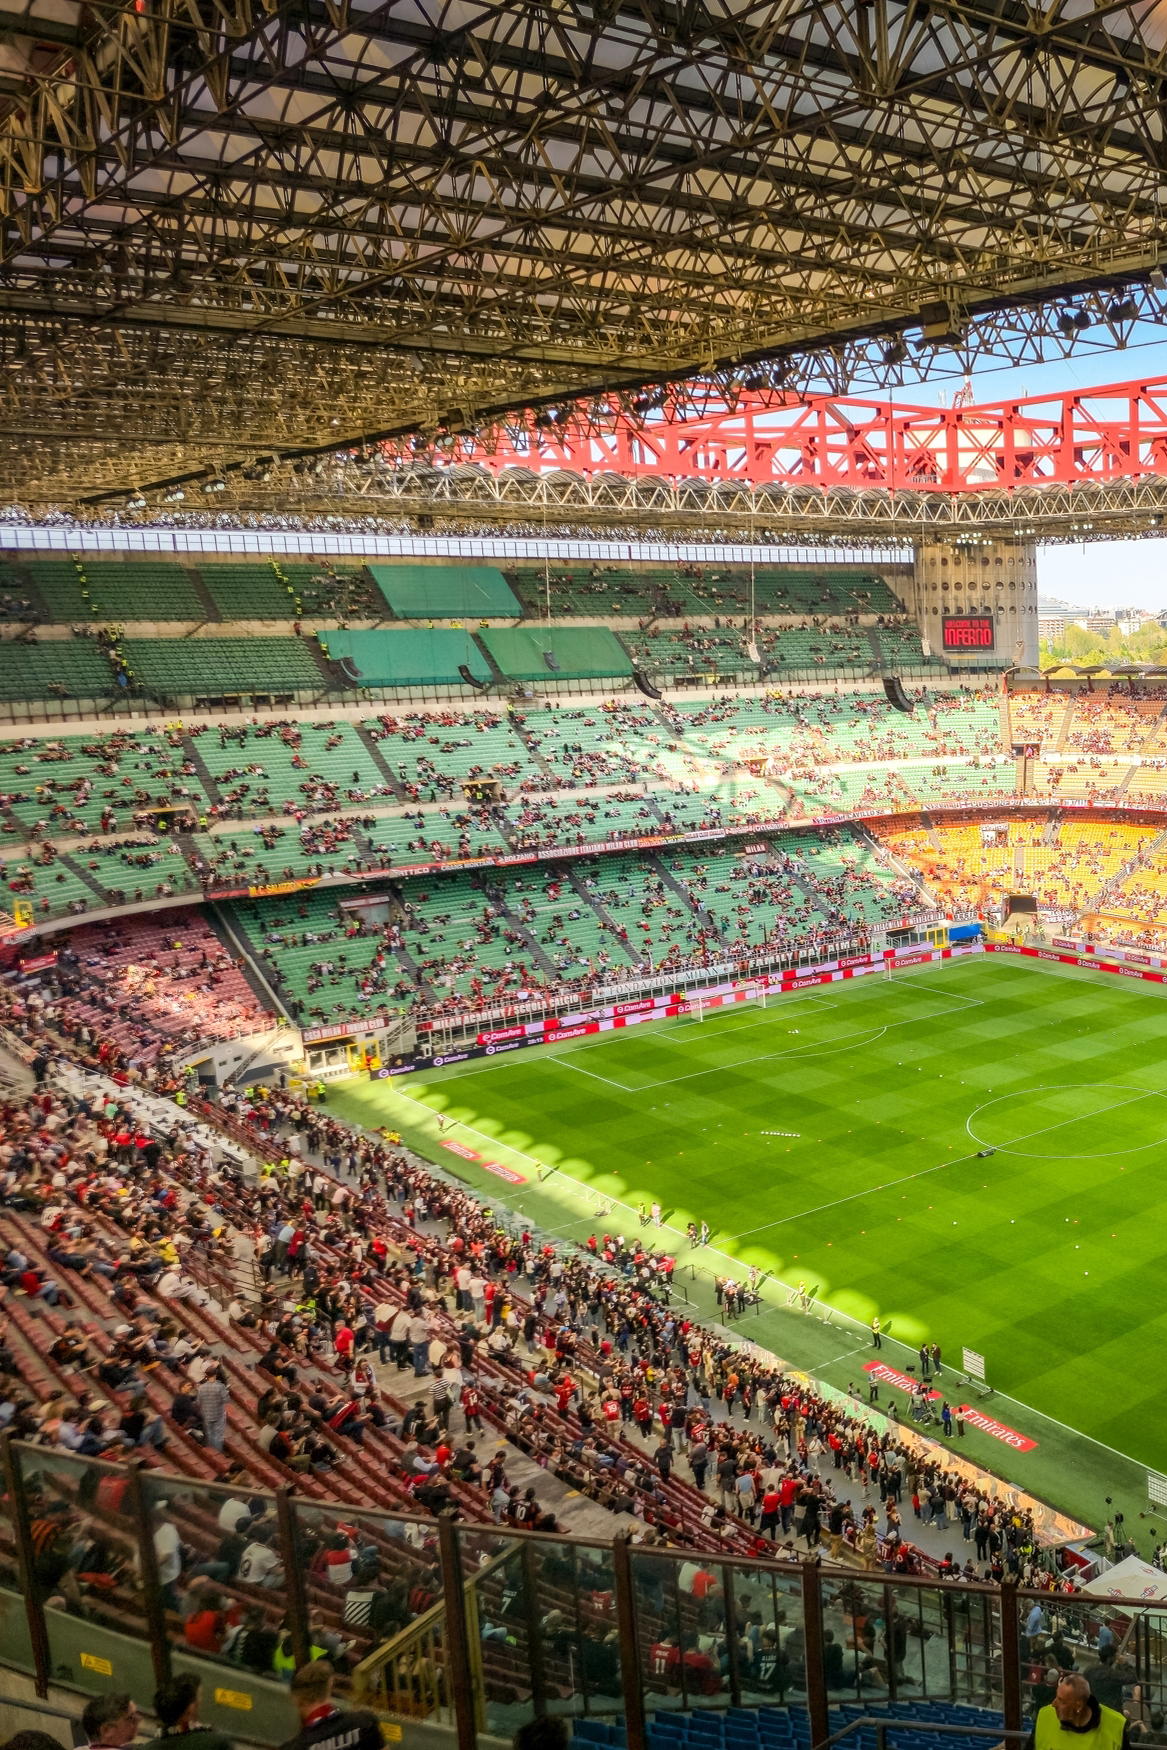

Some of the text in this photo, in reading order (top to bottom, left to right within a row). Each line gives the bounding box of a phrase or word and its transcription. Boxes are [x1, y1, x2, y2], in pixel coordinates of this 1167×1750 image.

[944, 628, 992, 646] INFERNO
[745, 844, 766, 854] MILAN
[504, 853, 535, 863] BOLZANO
[901, 957, 922, 966] ComAve
[1082, 960, 1100, 969] ComAve
[1124, 968, 1143, 978] ComAve
[609, 967, 719, 995] FONDAZIONE MILAN
[798, 977, 822, 987] ComAve
[432, 1015, 463, 1030] MILAN
[464, 1007, 503, 1024] ACADEMY
[514, 999, 547, 1015] SCUOLA
[550, 994, 580, 1006] CALCIO
[624, 1000, 651, 1012] ComAve
[555, 1028, 586, 1041] ComAve
[963, 1408, 1025, 1448] Emirates
[515, 1505, 527, 1520] 10
[655, 1658, 666, 1674] 11
[760, 1662, 777, 1680] 17
